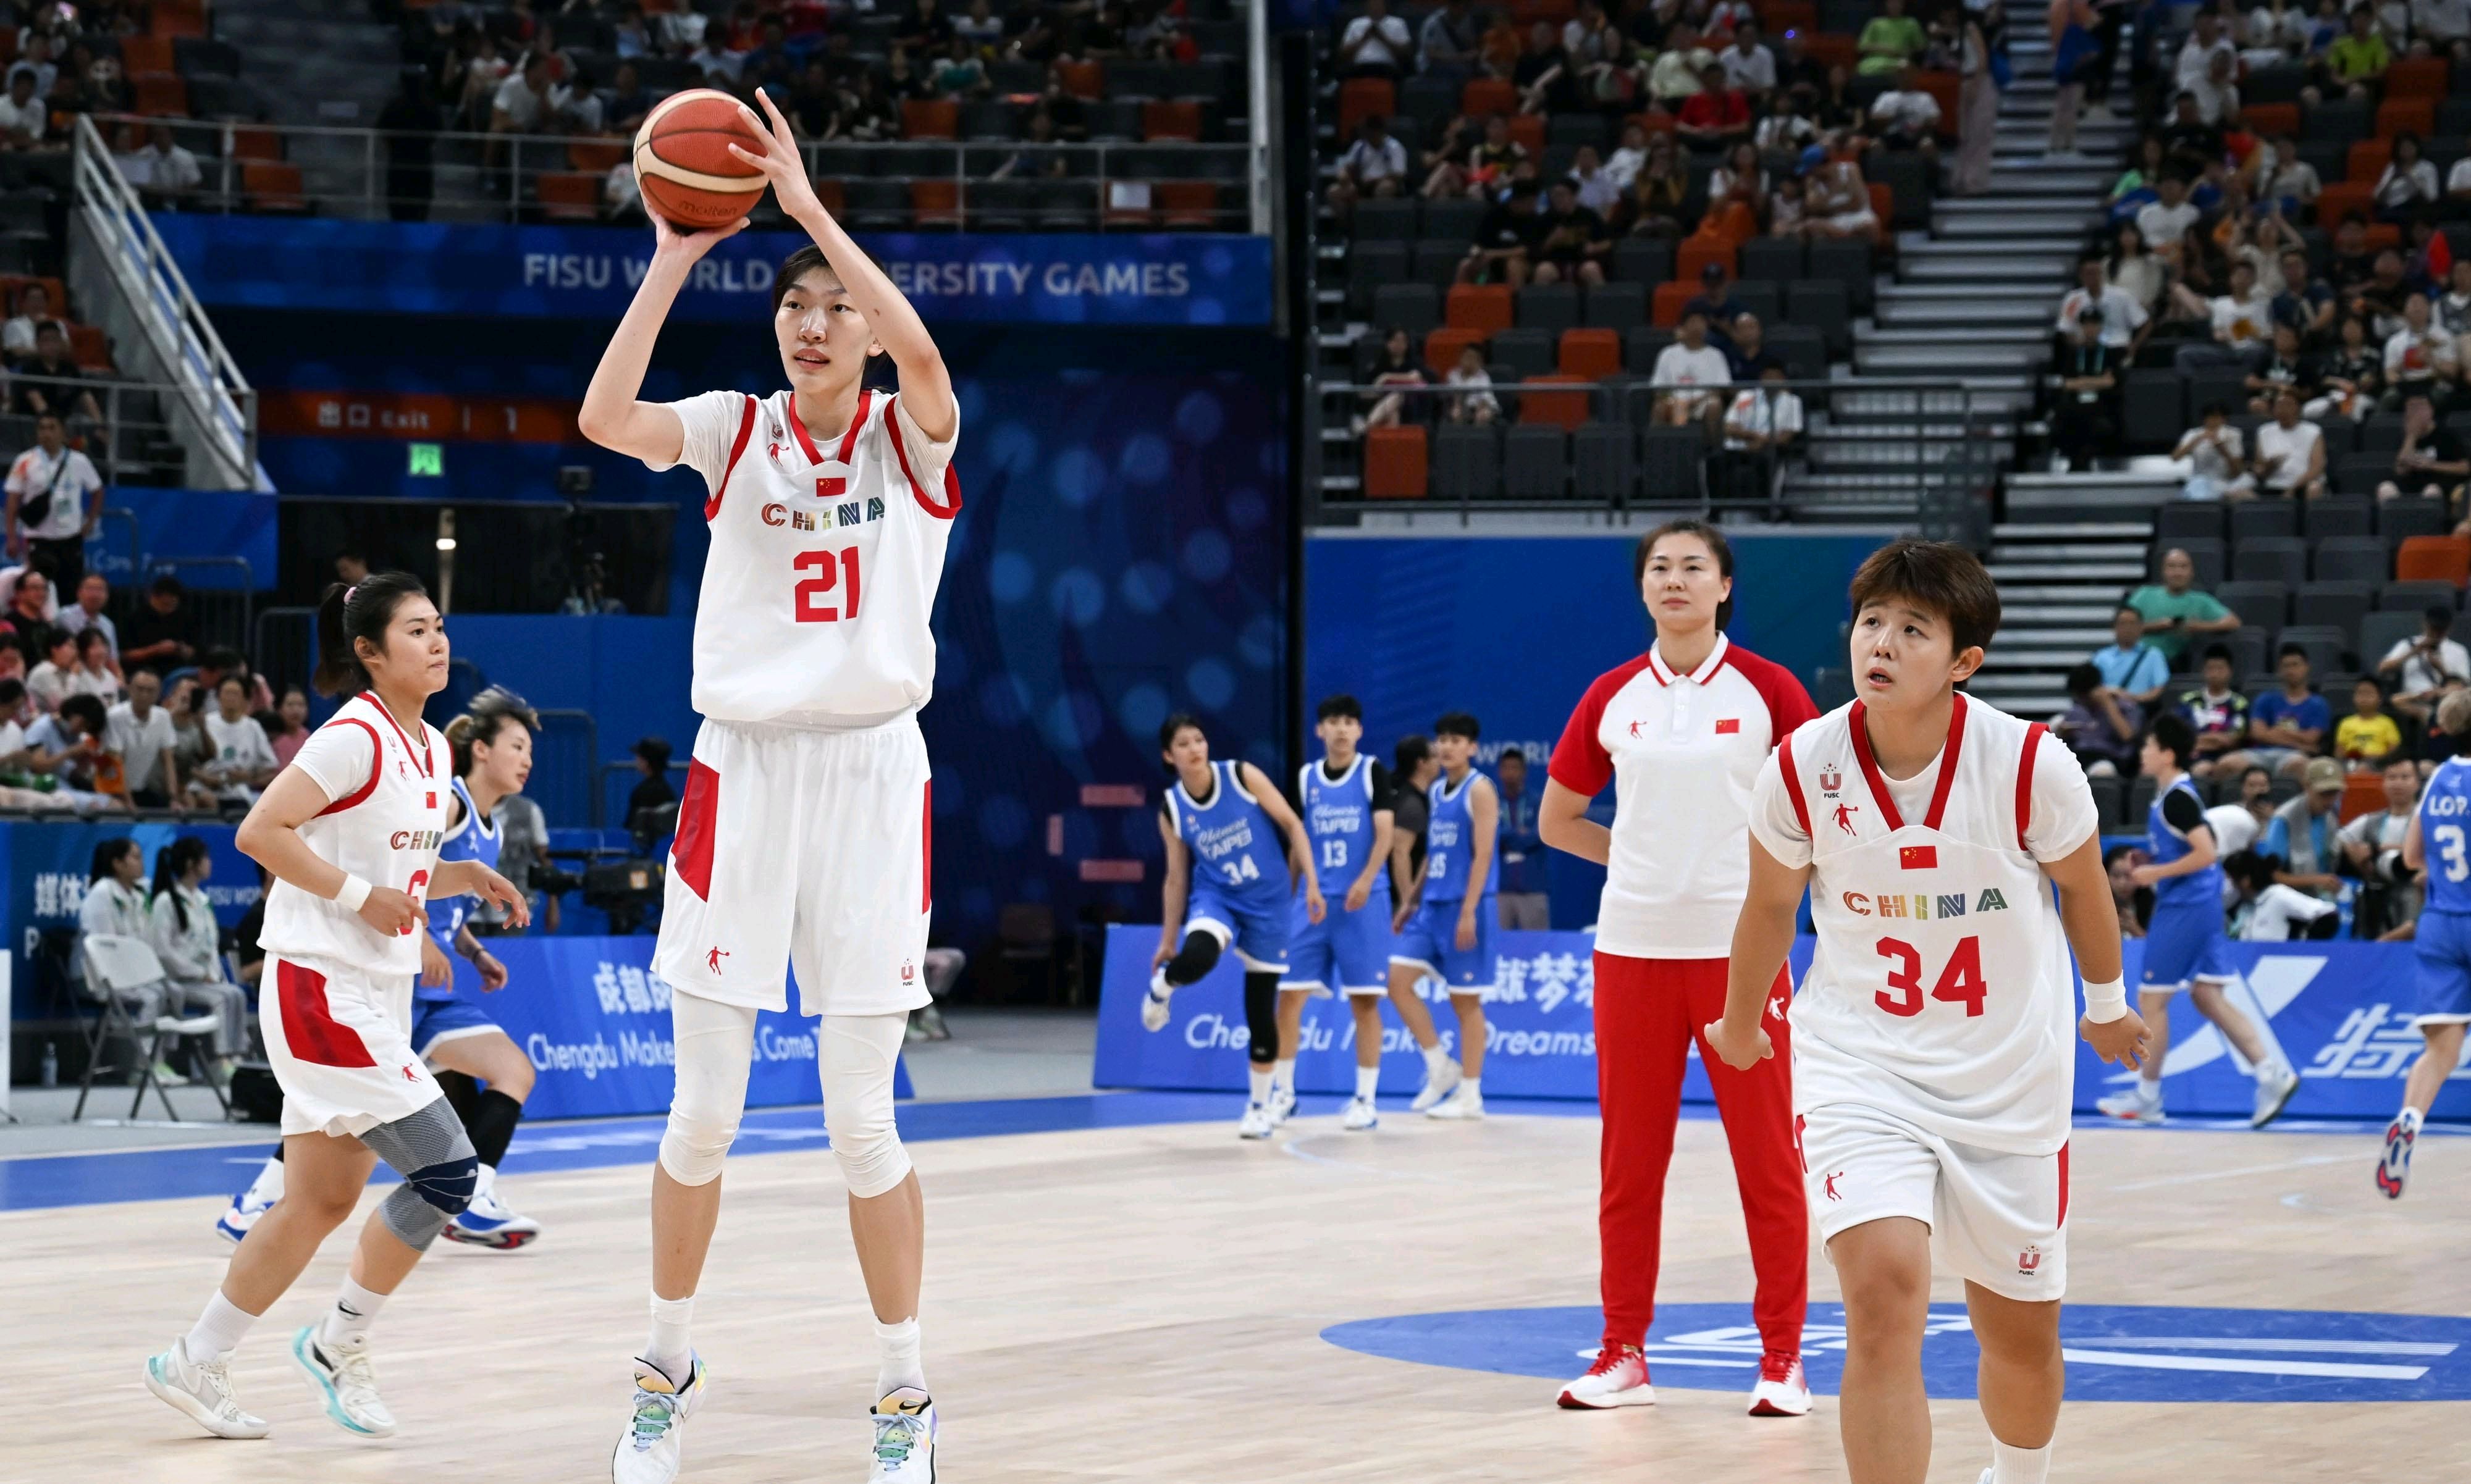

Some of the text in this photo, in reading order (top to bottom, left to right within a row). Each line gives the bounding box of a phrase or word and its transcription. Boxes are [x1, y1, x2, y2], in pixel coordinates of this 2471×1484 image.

[524, 253, 1190, 296] FISU WRLD ERSITY GAMES
[761, 497, 886, 531] CHINA
[793, 546, 860, 623] 21
[390, 831, 444, 850] CHIN
[1323, 839, 1347, 868] 13
[35, 873, 91, 918] 媒体
[1843, 888, 2008, 920] CHINA
[1875, 936, 1987, 1017] 34
[527, 1031, 619, 1080] Chengdu
[619, 1029, 676, 1067] Make
[760, 1025, 816, 1062] Come
[1185, 1014, 1333, 1051] Chedu
